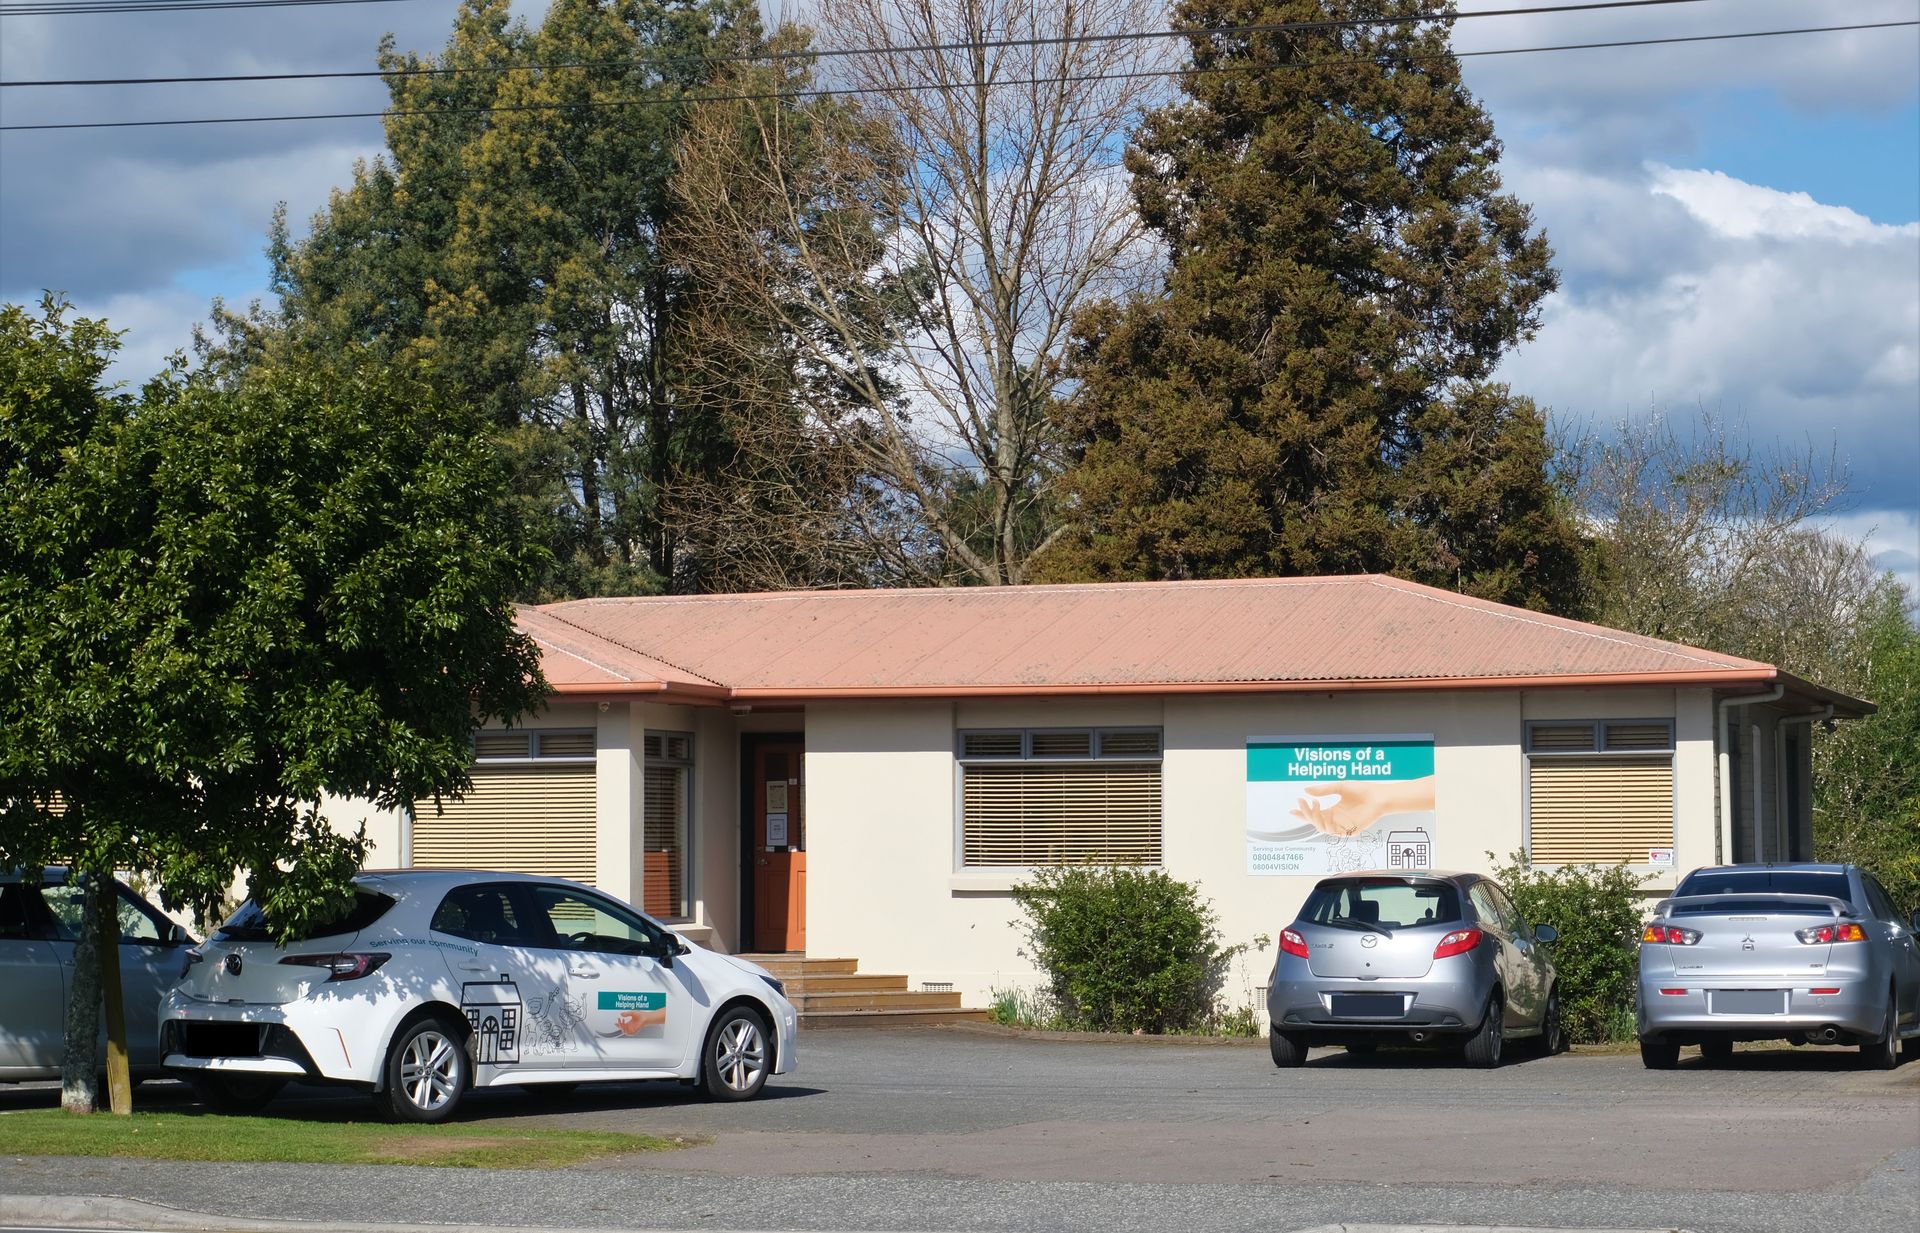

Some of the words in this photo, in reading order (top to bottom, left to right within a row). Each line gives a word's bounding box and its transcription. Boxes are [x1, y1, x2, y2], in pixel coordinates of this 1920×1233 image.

[1294, 747, 1351, 761] Visions
[1355, 747, 1372, 761] of
[1375, 749, 1384, 760] a
[1288, 762, 1347, 779] Helping
[1351, 762, 1391, 776] Hand
[369, 937, 408, 948] Serving
[428, 939, 479, 957] community
[617, 993, 637, 1002] Visions
[615, 1001, 635, 1010] Helping
[635, 1001, 650, 1009] Hand
